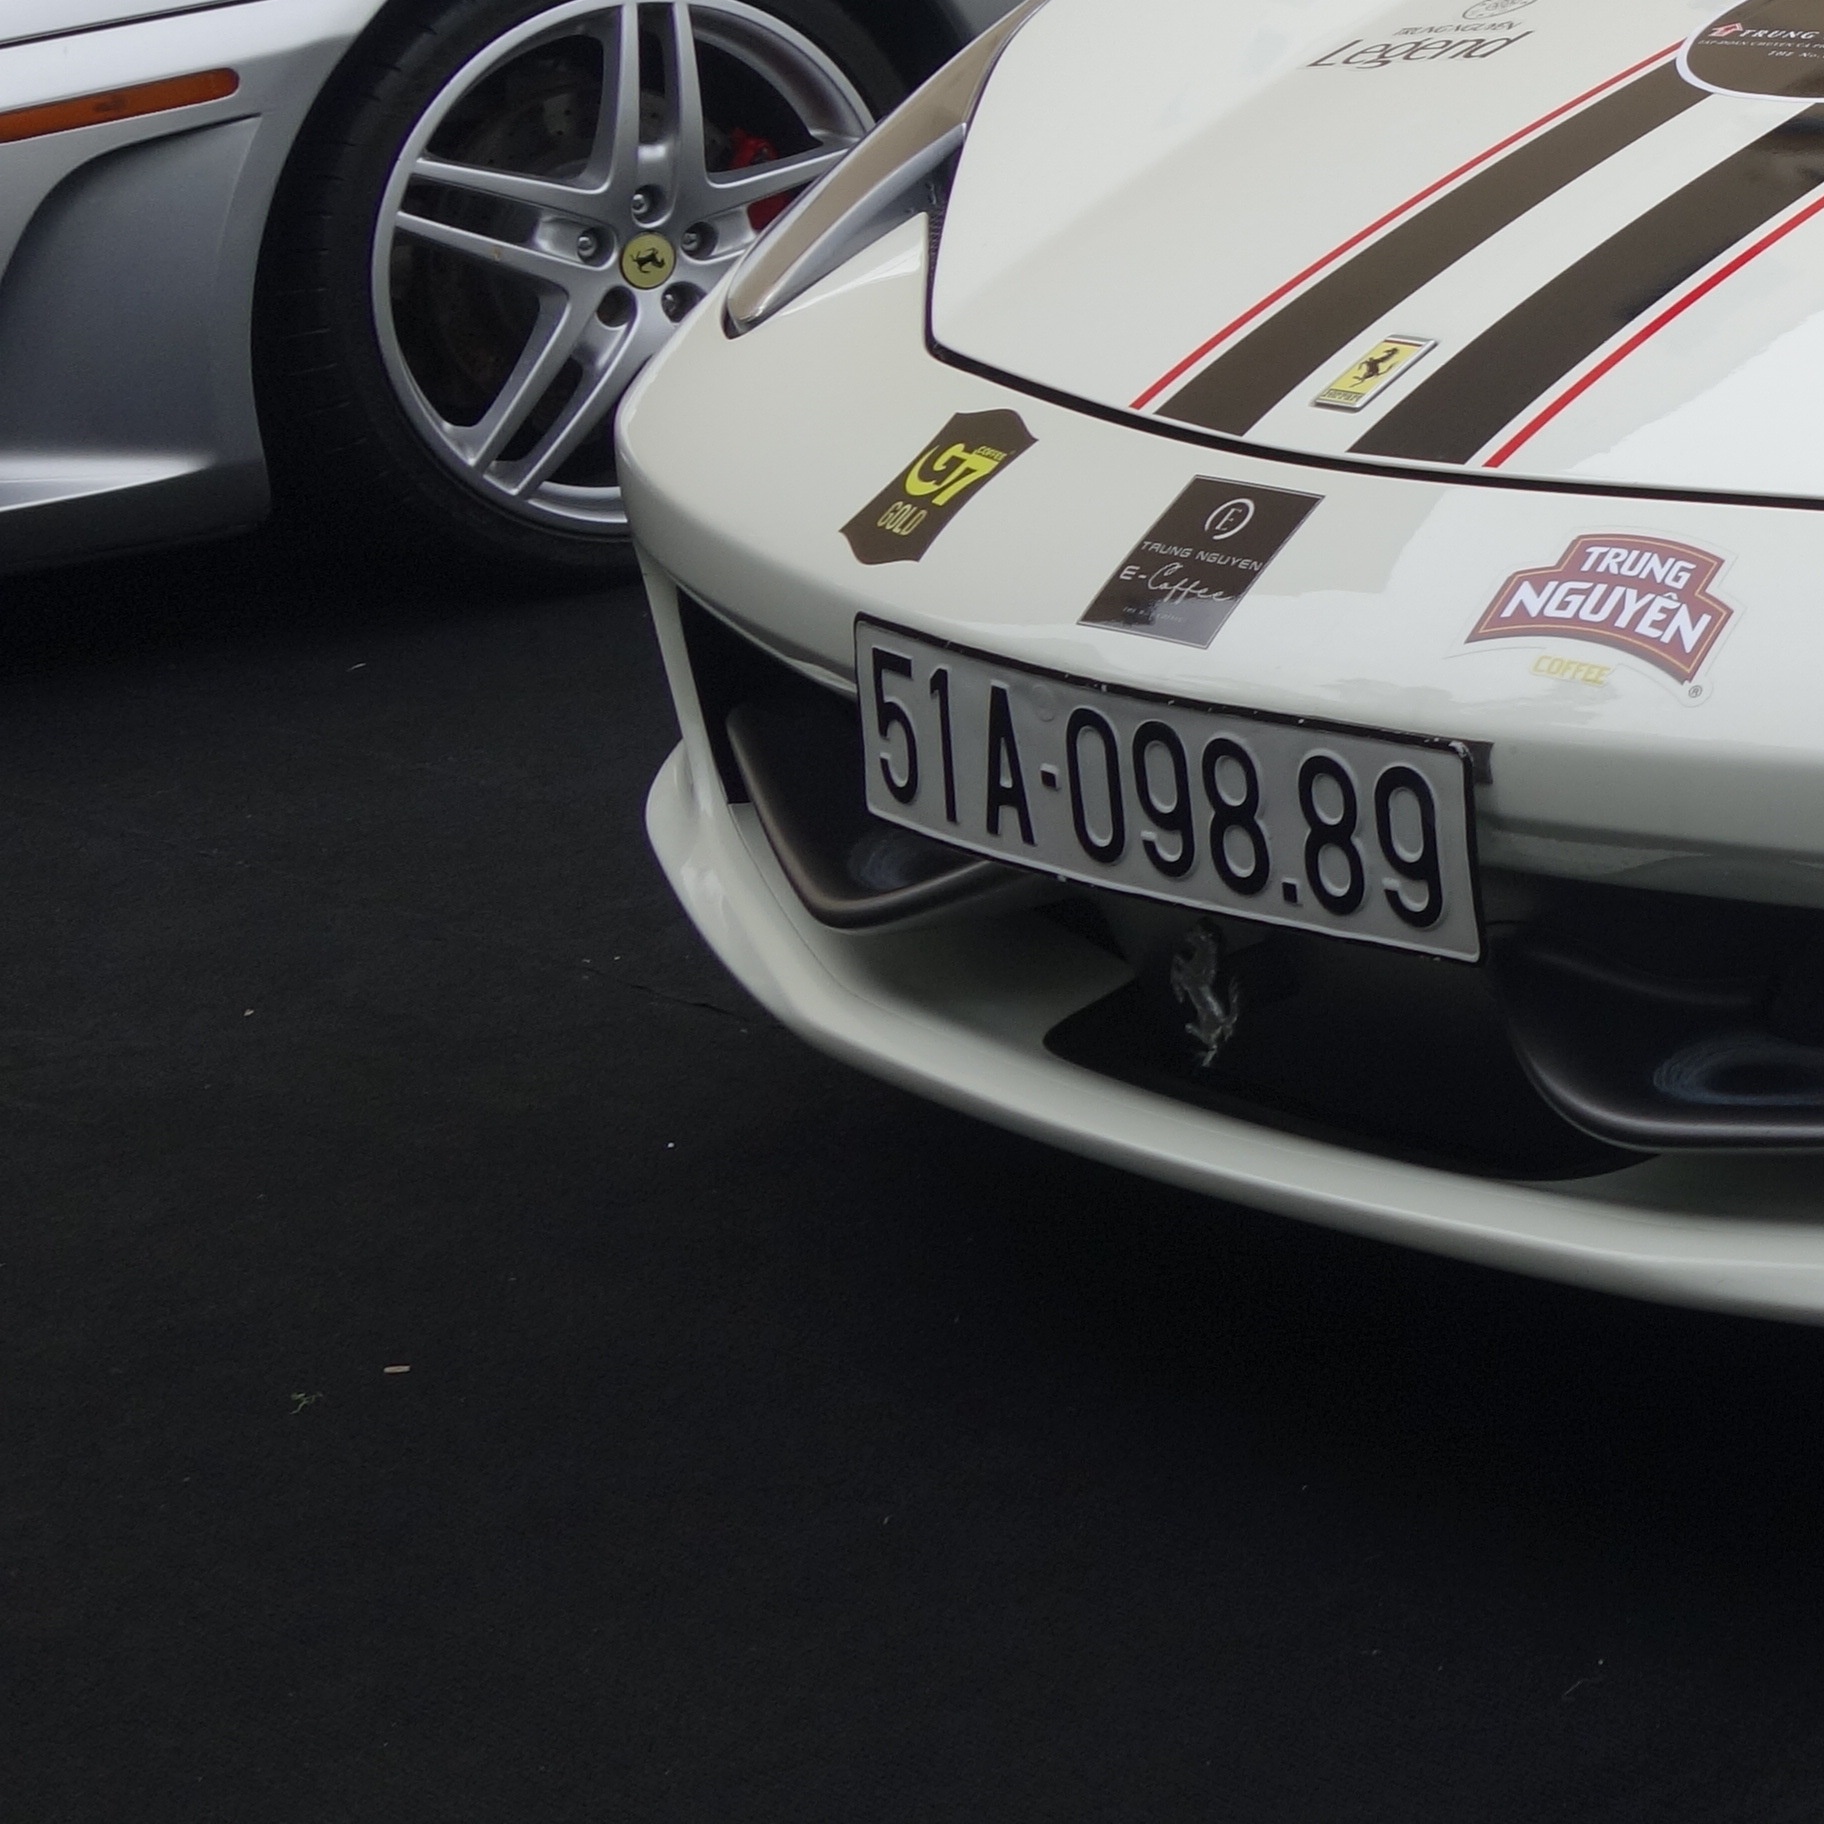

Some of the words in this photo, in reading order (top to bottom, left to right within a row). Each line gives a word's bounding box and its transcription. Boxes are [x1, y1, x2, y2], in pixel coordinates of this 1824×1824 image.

[1307, 30, 1534, 69] Legend
[1740, 29, 1820, 40] TRUNG
[905, 442, 999, 506] G7
[877, 501, 928, 536] GOLD
[1141, 541, 1193, 558] TRUNG
[1580, 545, 1697, 590] TRUNG
[1500, 580, 1712, 654] NGUYÊN
[1531, 655, 1613, 686] COFFEE
[870, 646, 1444, 930] 51A-098.89
